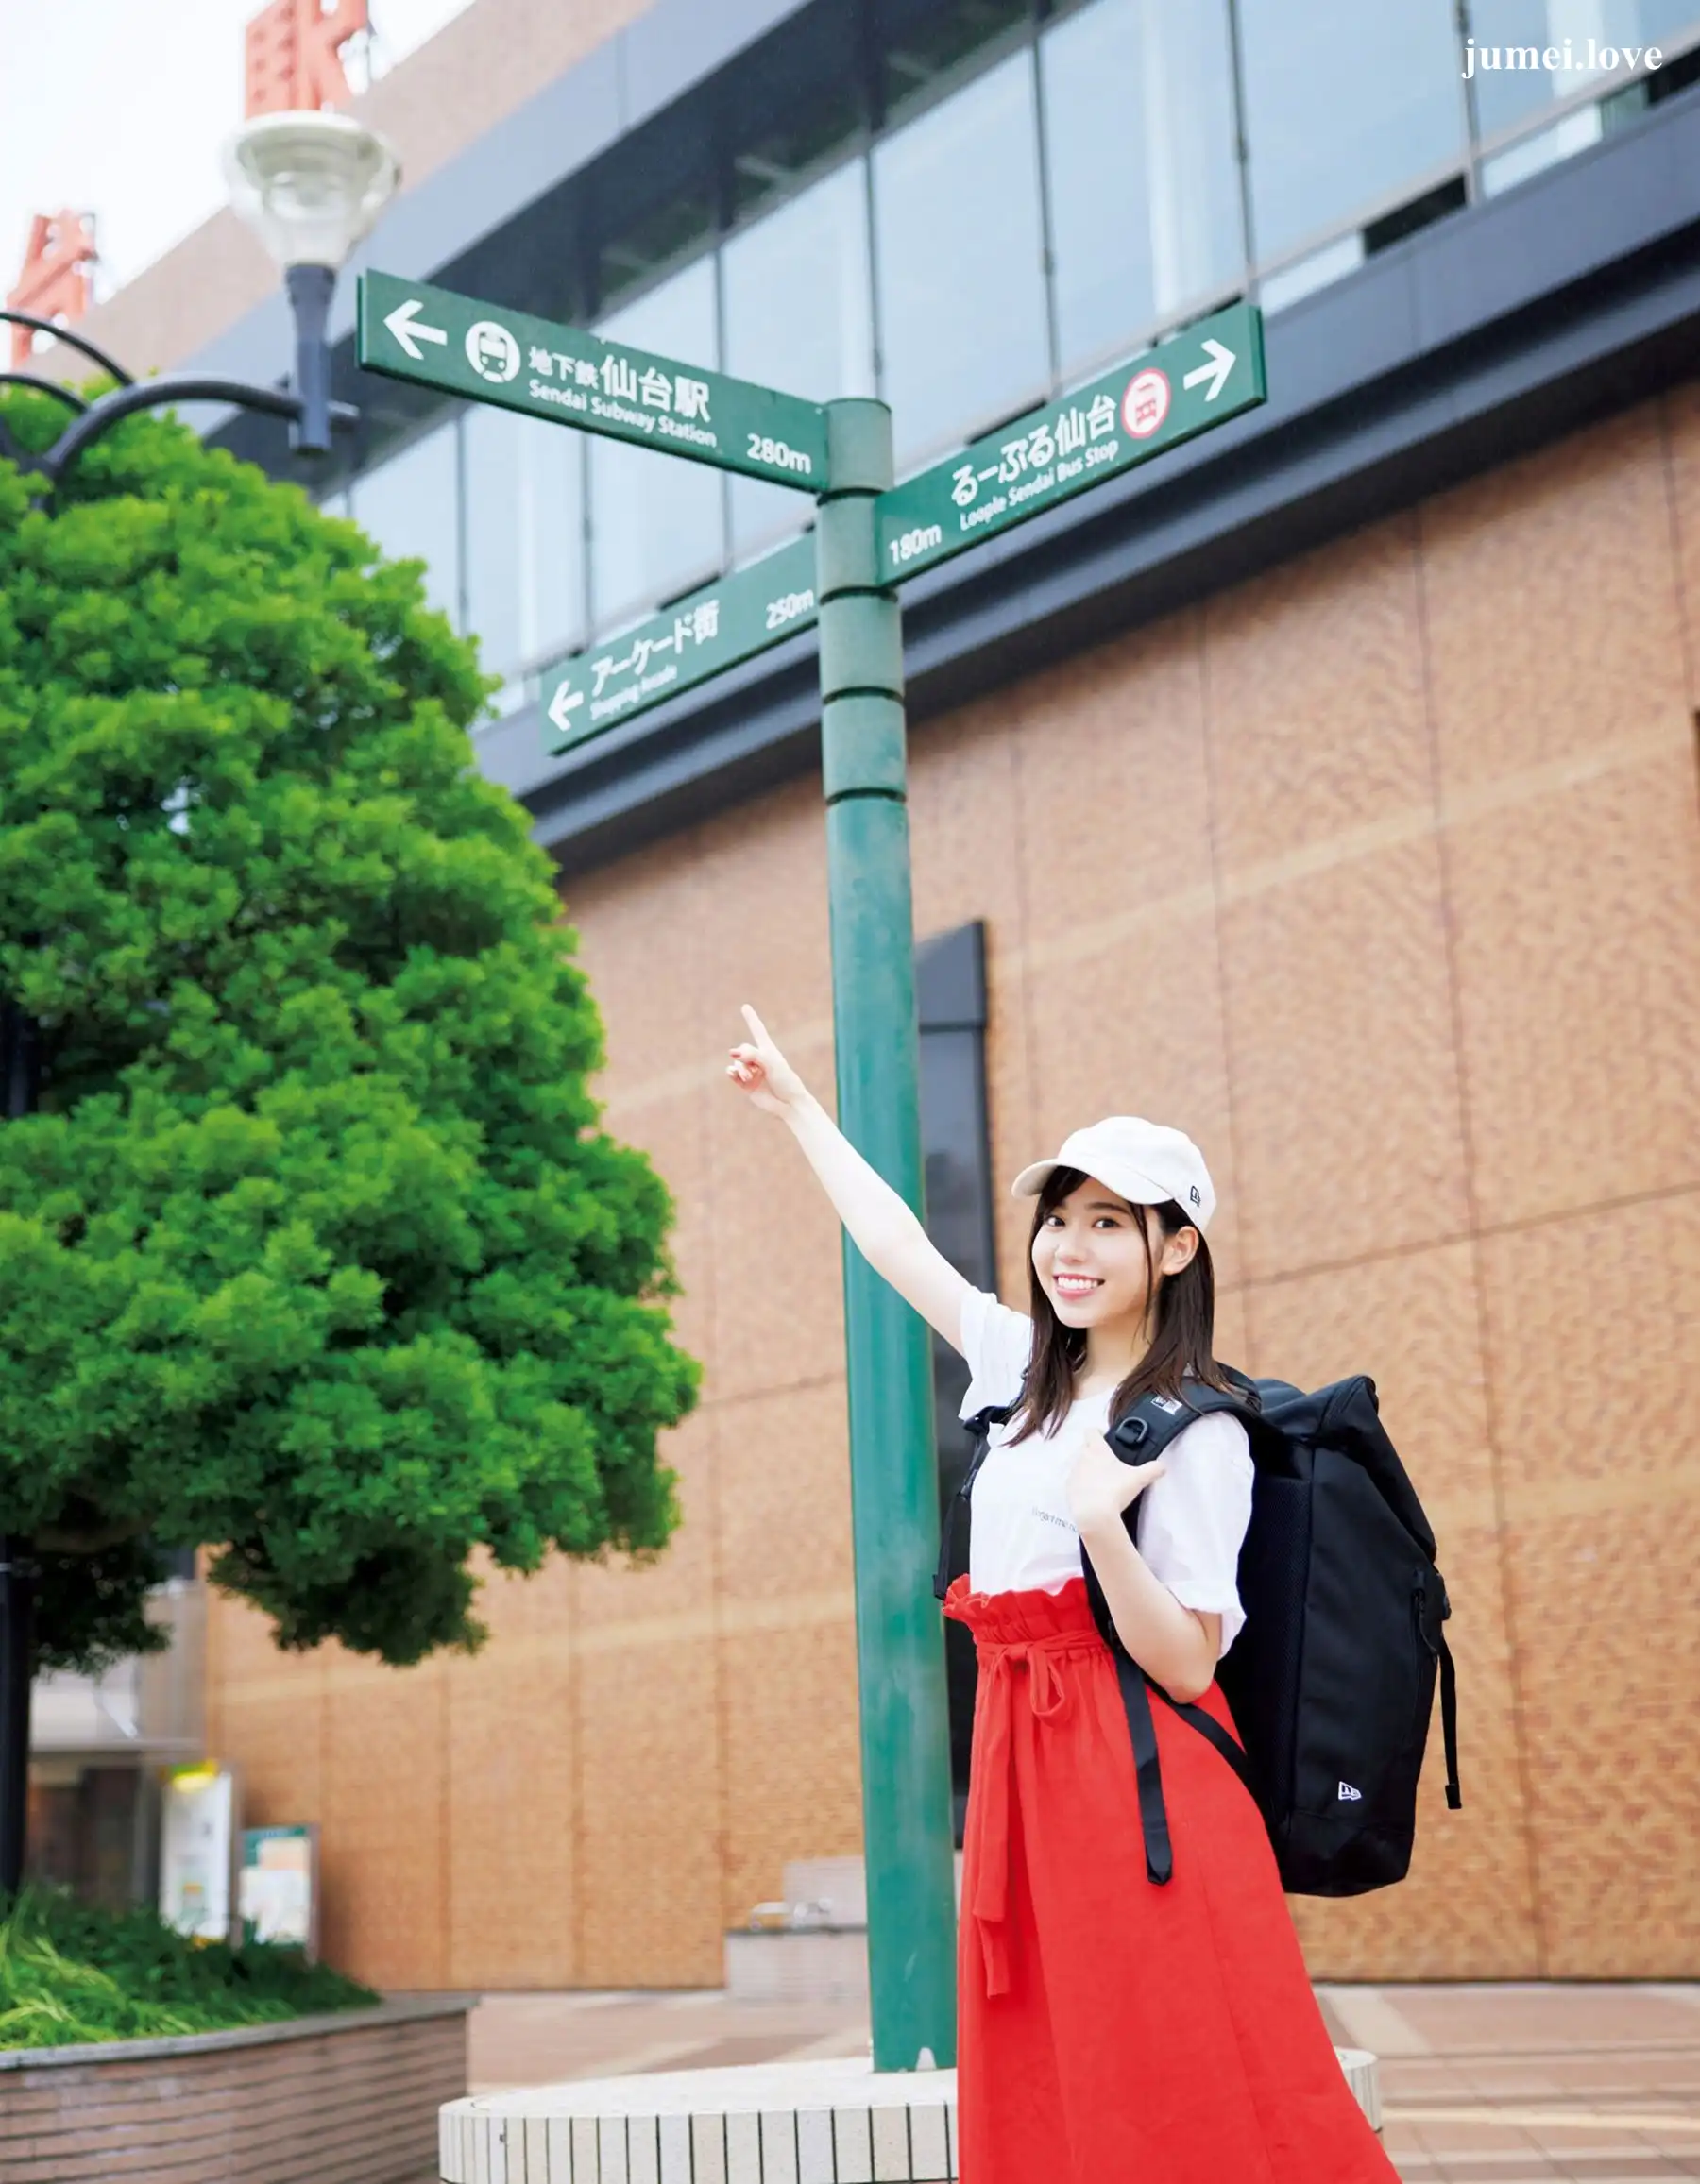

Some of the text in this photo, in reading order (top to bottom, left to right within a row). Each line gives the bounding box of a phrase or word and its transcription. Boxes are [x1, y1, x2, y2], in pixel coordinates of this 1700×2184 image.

[529, 379, 718, 448] Sendai Subway Station
[746, 432, 812, 474] 280m
[951, 394, 1117, 506] るーぷる仙台
[960, 440, 1119, 531] Loople Sendai Bus Stop
[889, 522, 942, 565] 180m
[766, 589, 814, 630] 250m
